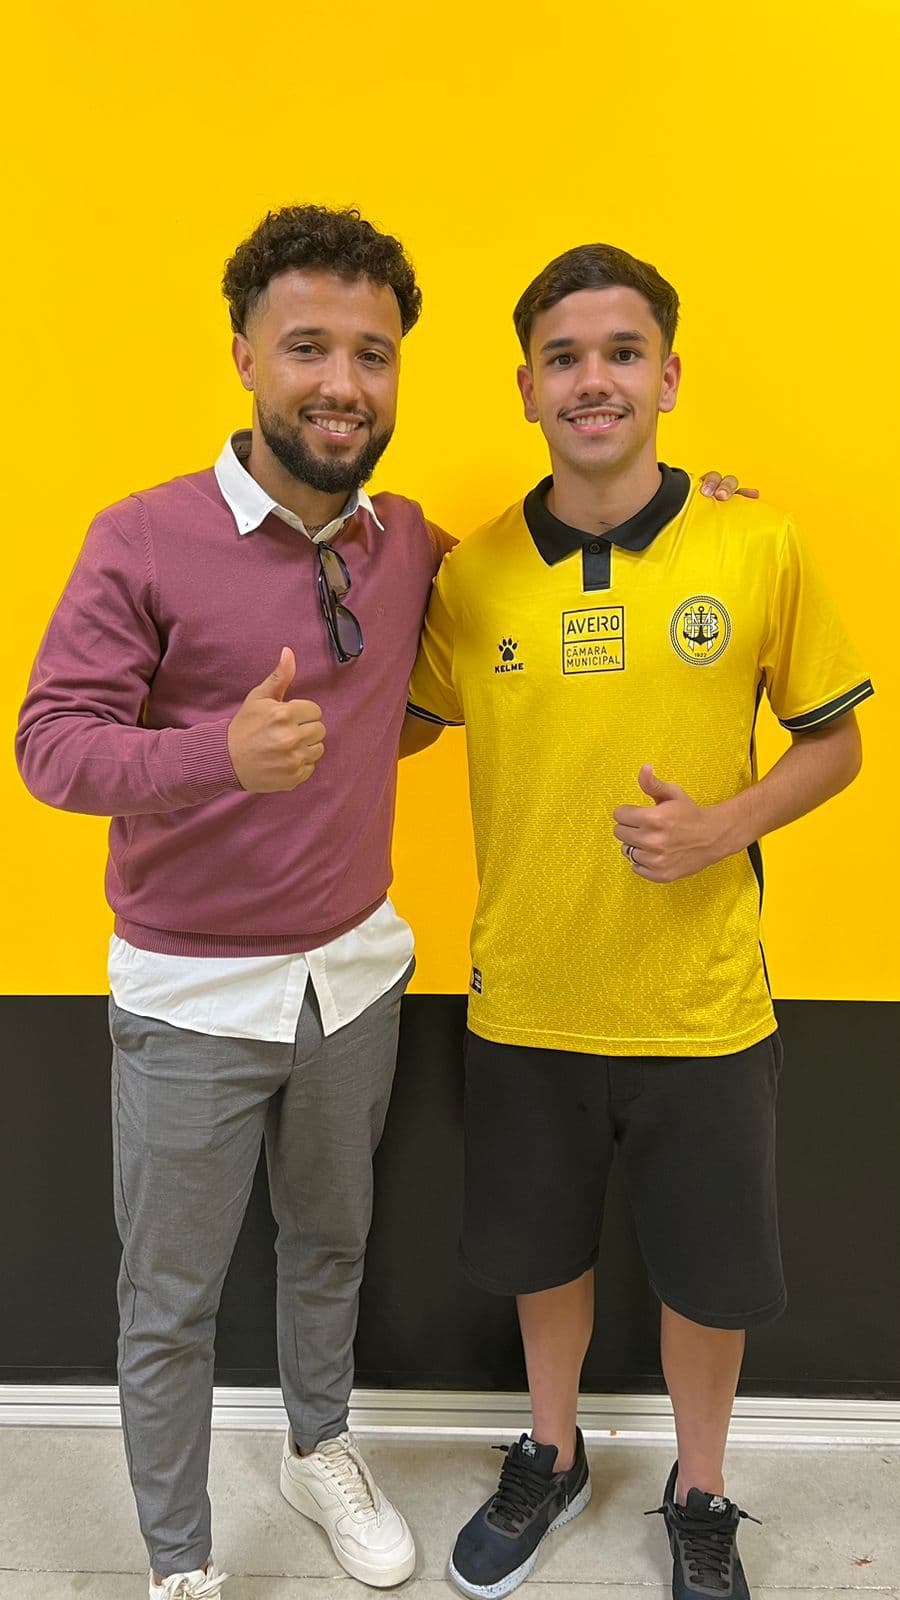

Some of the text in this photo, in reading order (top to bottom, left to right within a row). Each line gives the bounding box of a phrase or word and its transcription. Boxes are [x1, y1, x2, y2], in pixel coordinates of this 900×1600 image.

[566, 615, 620, 635] AVEIRO
[494, 662, 524, 674] KELME
[566, 655, 620, 668] MUNICIPAL
